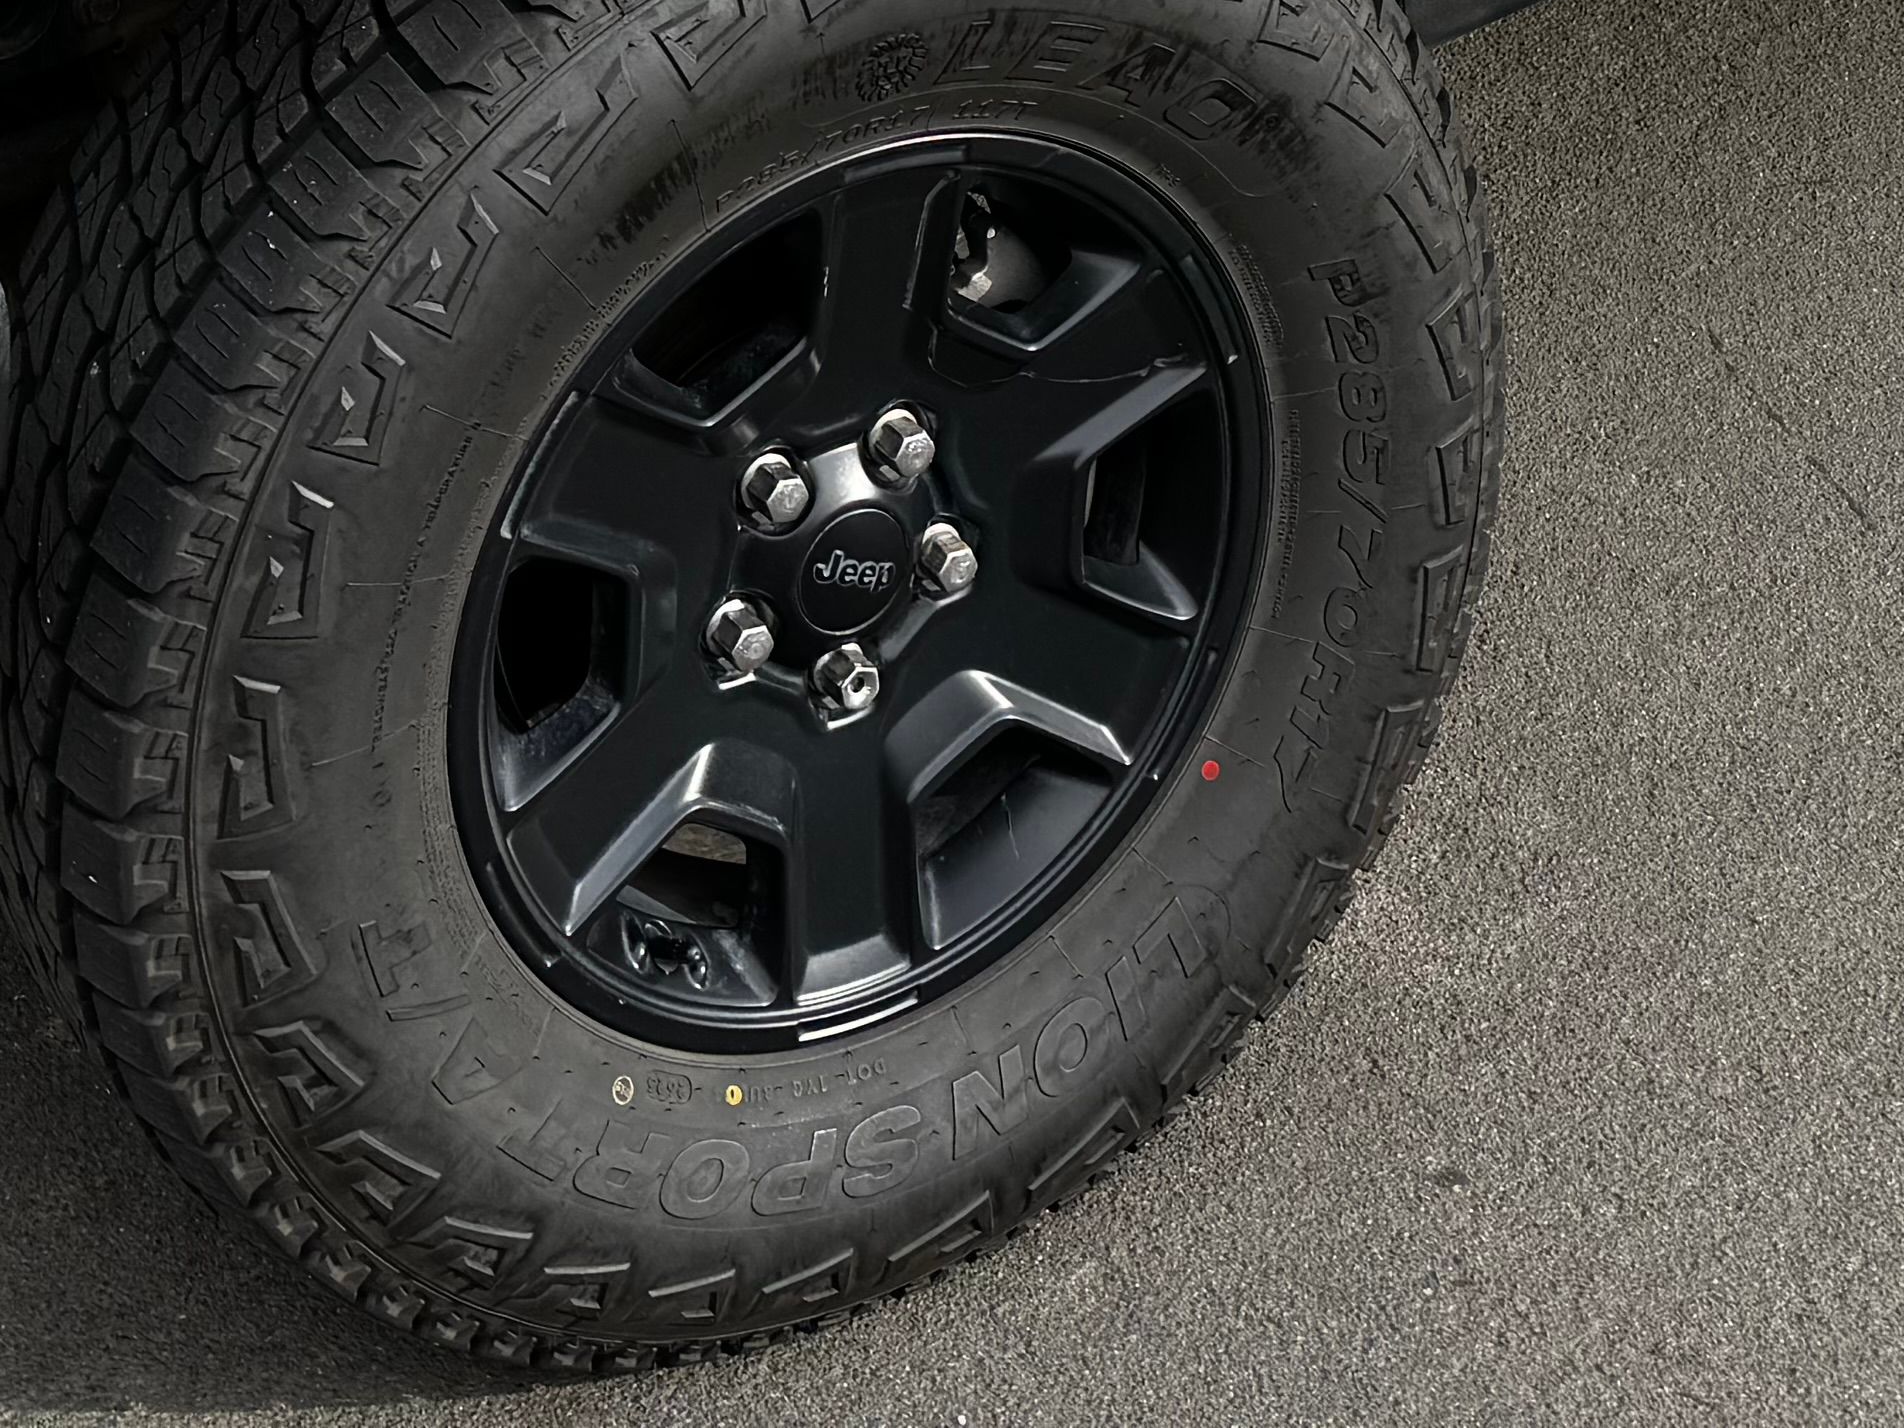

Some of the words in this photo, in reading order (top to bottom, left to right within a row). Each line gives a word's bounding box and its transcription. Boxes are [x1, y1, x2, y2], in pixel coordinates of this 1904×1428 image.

[952, 100, 1039, 121] 117T
[813, 549, 896, 593] Jeep
[1272, 257, 1389, 814] P285/70R17
[951, 896, 1202, 1161] LION
[496, 1099, 921, 1221] SPORT
